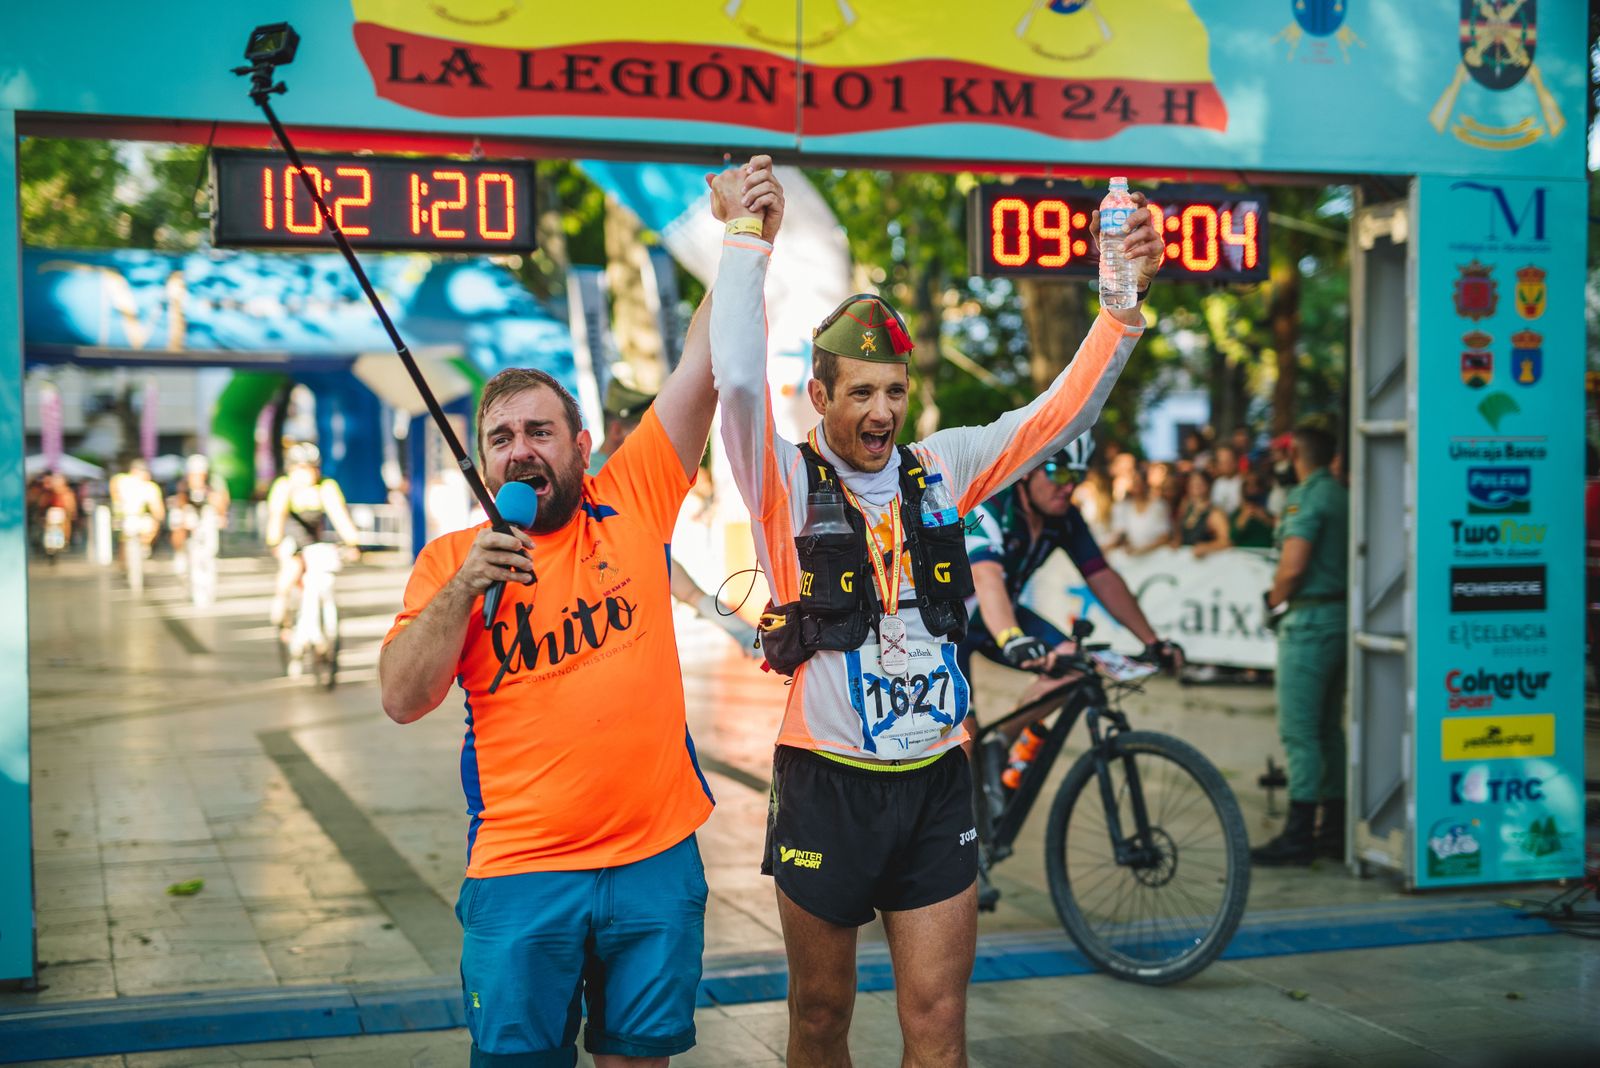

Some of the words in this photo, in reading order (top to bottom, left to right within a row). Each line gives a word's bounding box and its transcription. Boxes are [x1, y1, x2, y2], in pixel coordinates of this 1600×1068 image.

[385, 42, 493, 90] LA
[516, 53, 779, 107] LEGIÓN
[796, 68, 909, 113] 101
[941, 76, 1038, 119] KM
[1061, 83, 1141, 122] 24
[1161, 80, 1200, 126] H
[582, 640, 634, 668] HISTORIAS
[866, 671, 950, 718] 1627
[1445, 667, 1552, 699] Colnatur
[1487, 777, 1544, 804] TRC
[793, 857, 822, 870] SPORT
[795, 849, 823, 862] INTER
